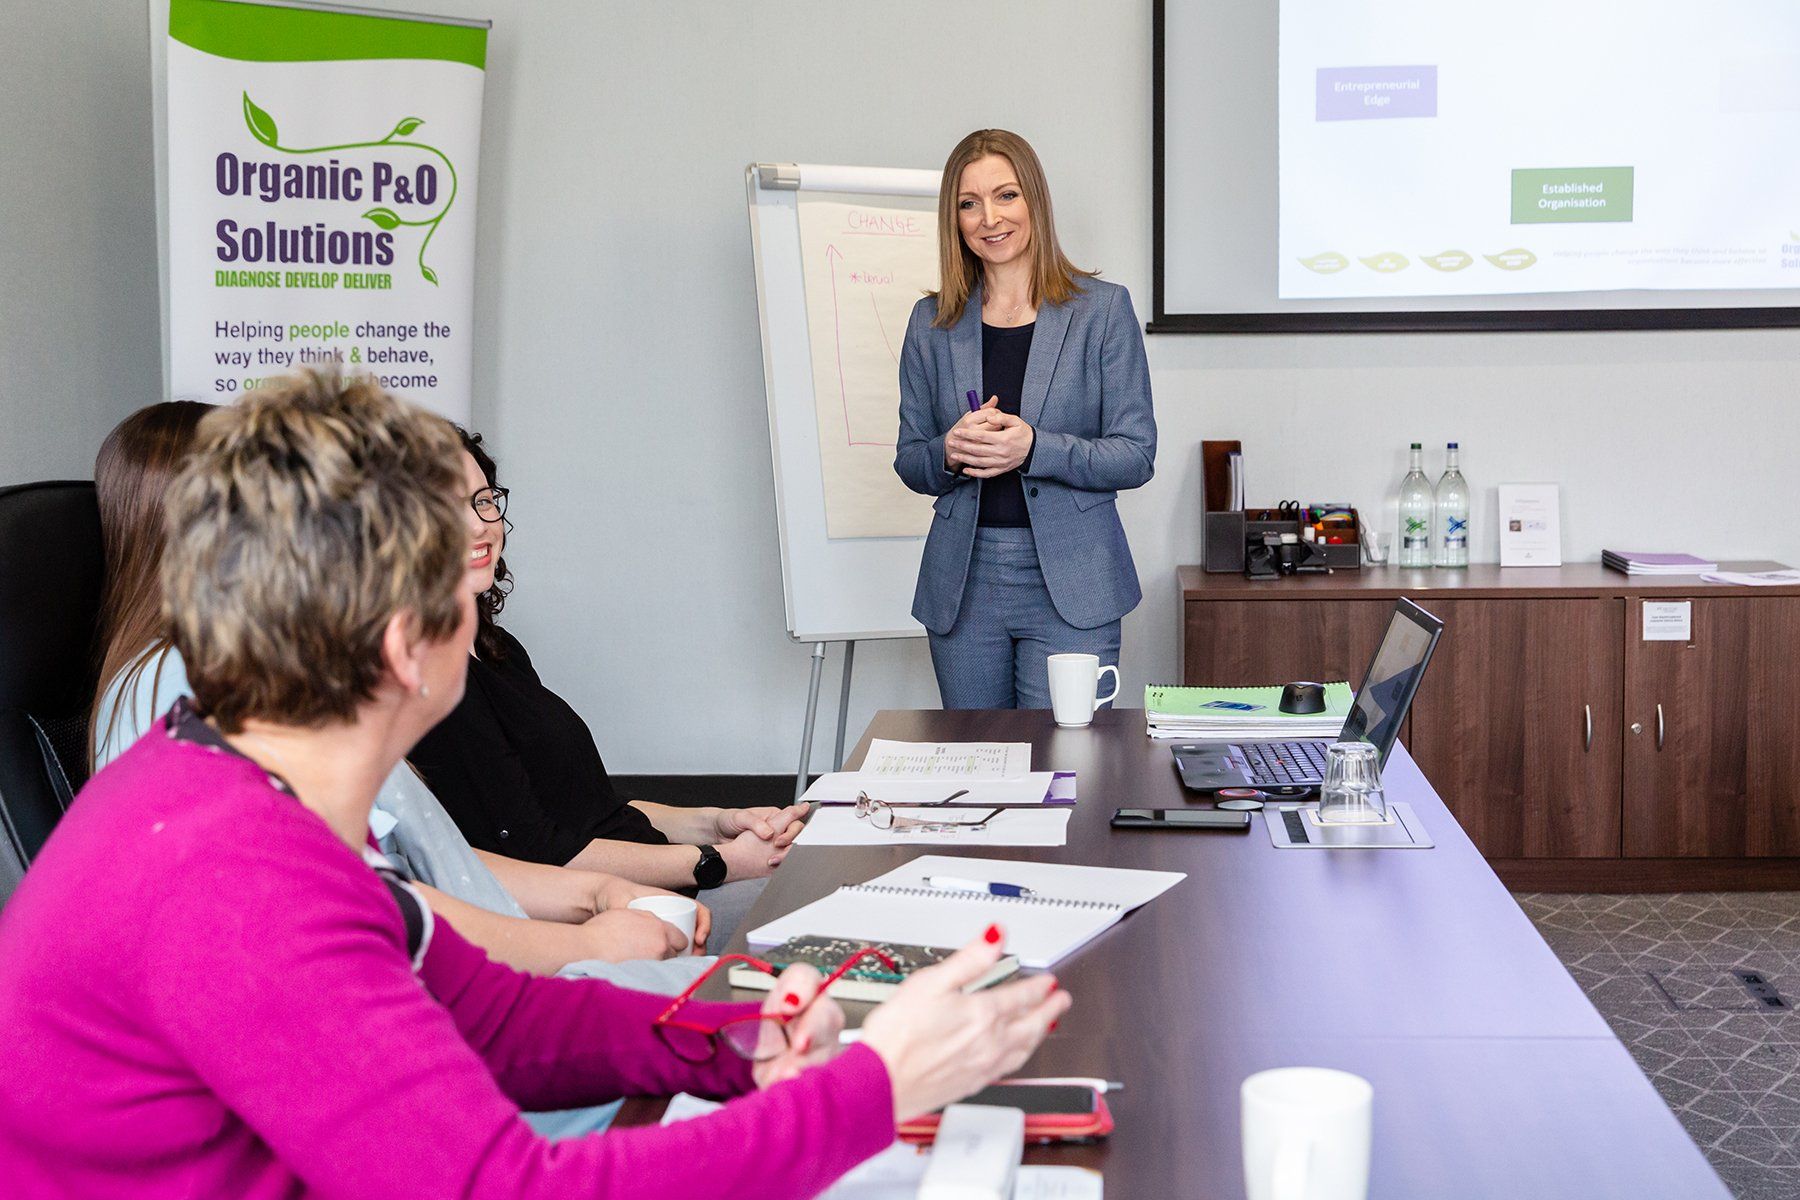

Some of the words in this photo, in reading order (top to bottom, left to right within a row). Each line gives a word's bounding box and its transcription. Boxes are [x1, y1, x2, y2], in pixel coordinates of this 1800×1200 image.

[1333, 78, 1420, 93] Entrepreneurial
[1363, 94, 1391, 107] Edge
[215, 151, 363, 203] Organic
[372, 161, 438, 205] P&O
[1542, 181, 1604, 194] Established
[1538, 197, 1607, 211] Organisation
[847, 210, 921, 236] CHANGE
[215, 218, 395, 266] Solutions
[215, 270, 281, 289] DIAGNOSE
[285, 271, 339, 289] DEVELOP
[343, 273, 393, 290] DELIVER
[214, 321, 284, 343] Helping
[289, 321, 350, 342] people
[355, 321, 418, 341] change
[424, 322, 451, 338] the
[214, 350, 252, 369] way
[257, 347, 294, 368] they
[299, 347, 344, 365] think
[349, 346, 362, 364] &
[367, 346, 434, 366] behave,
[214, 377, 237, 392] so
